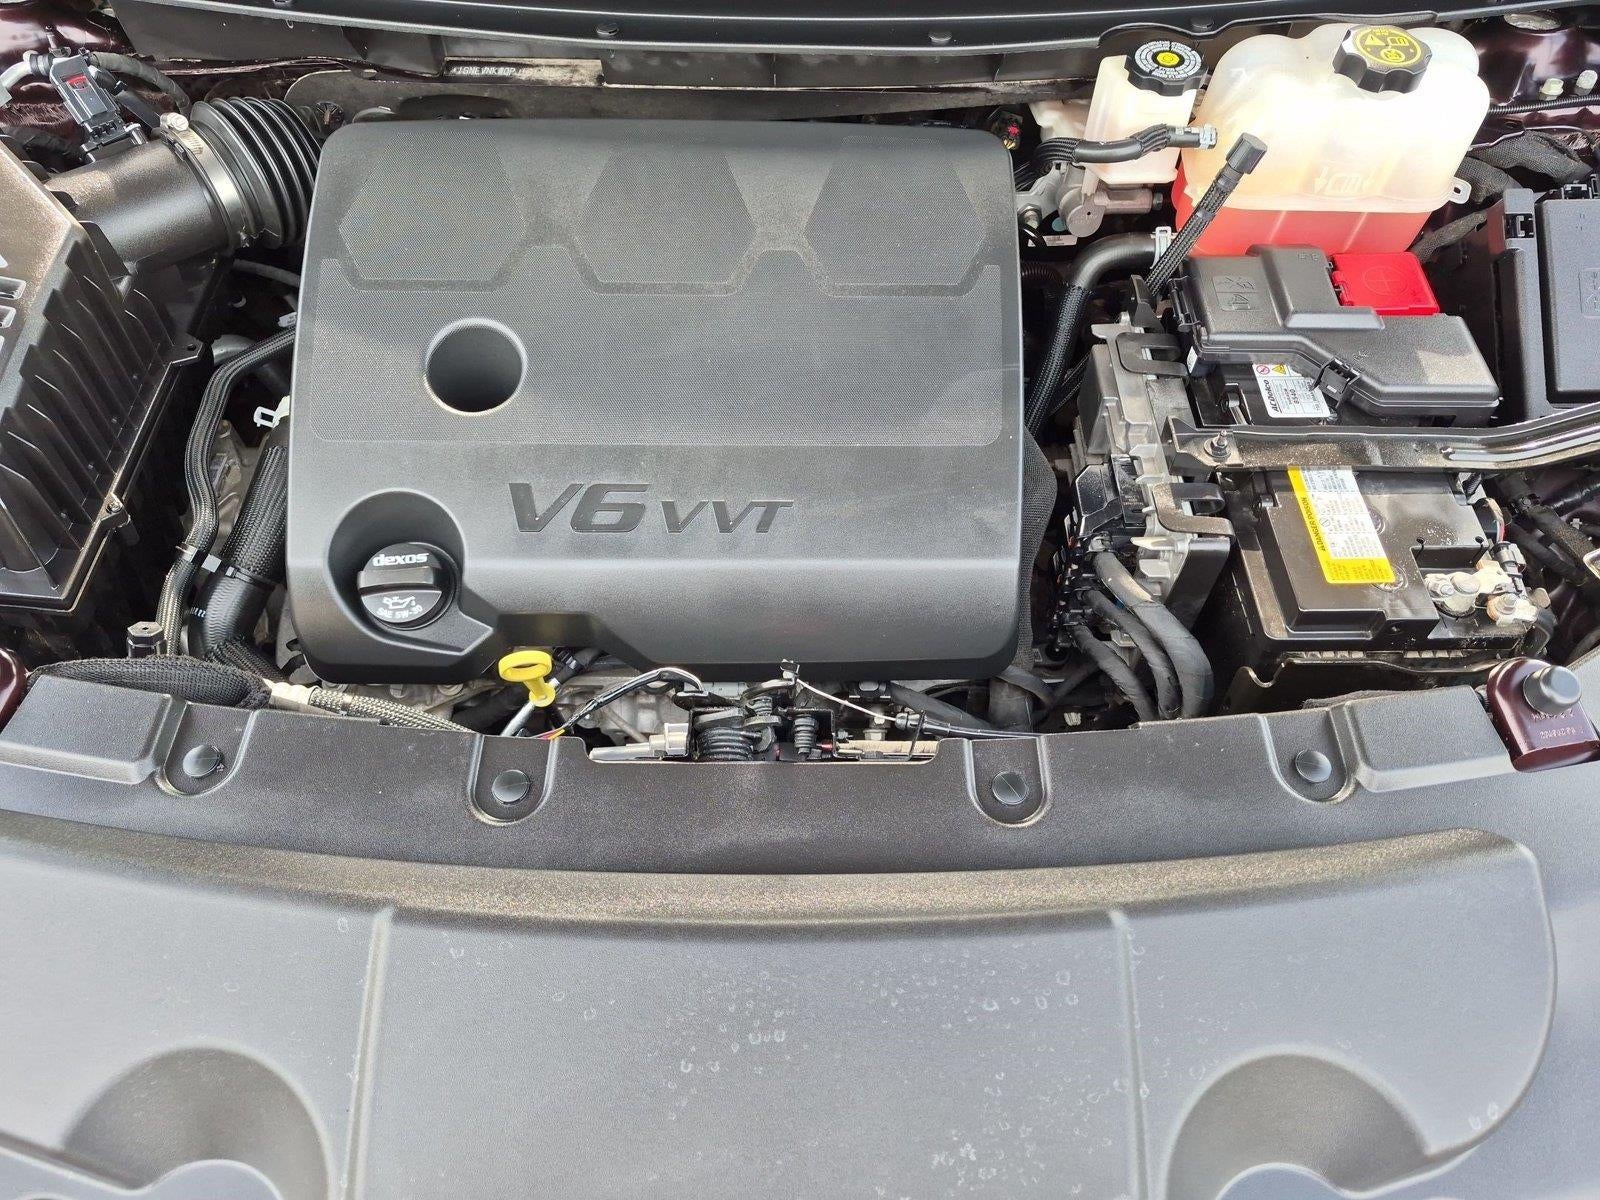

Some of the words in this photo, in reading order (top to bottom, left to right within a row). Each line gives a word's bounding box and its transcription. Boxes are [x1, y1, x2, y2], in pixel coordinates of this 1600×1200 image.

[508, 482, 651, 533] V6
[661, 499, 794, 533] VVT
[372, 553, 429, 566] dexos
[377, 607, 393, 619] SAE
[394, 605, 423, 619] 5W-30
